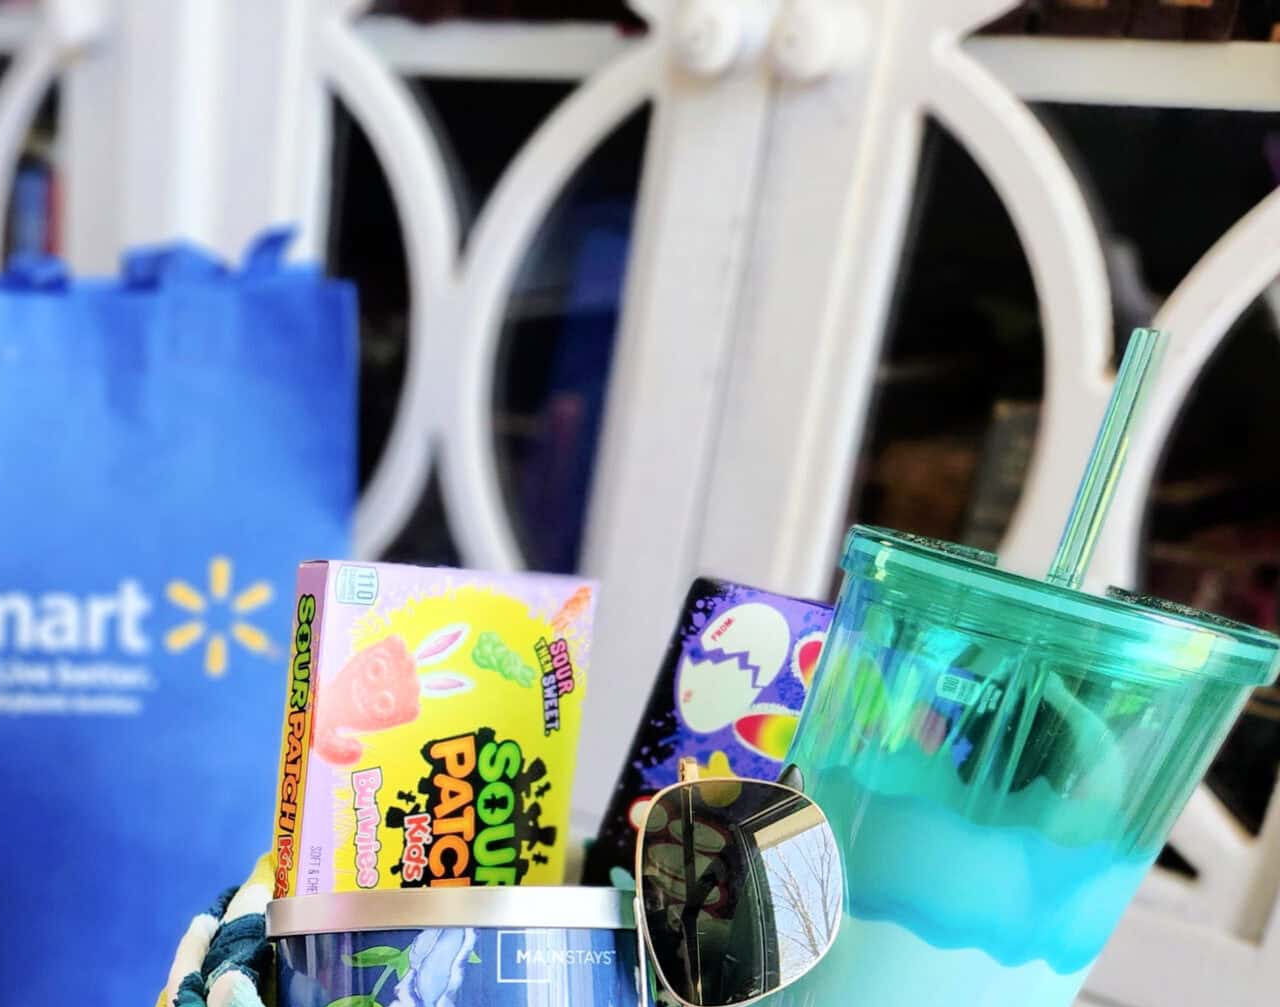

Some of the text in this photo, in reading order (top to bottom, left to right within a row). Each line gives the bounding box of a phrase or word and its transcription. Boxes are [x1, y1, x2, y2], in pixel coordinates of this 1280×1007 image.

[290, 594, 316, 711] SOUR
[549, 639, 574, 697] SOUR
[278, 708, 306, 834] PATCH
[429, 734, 477, 887] PATC
[304, 877, 319, 895] CHE
[403, 813, 433, 882] Kids
